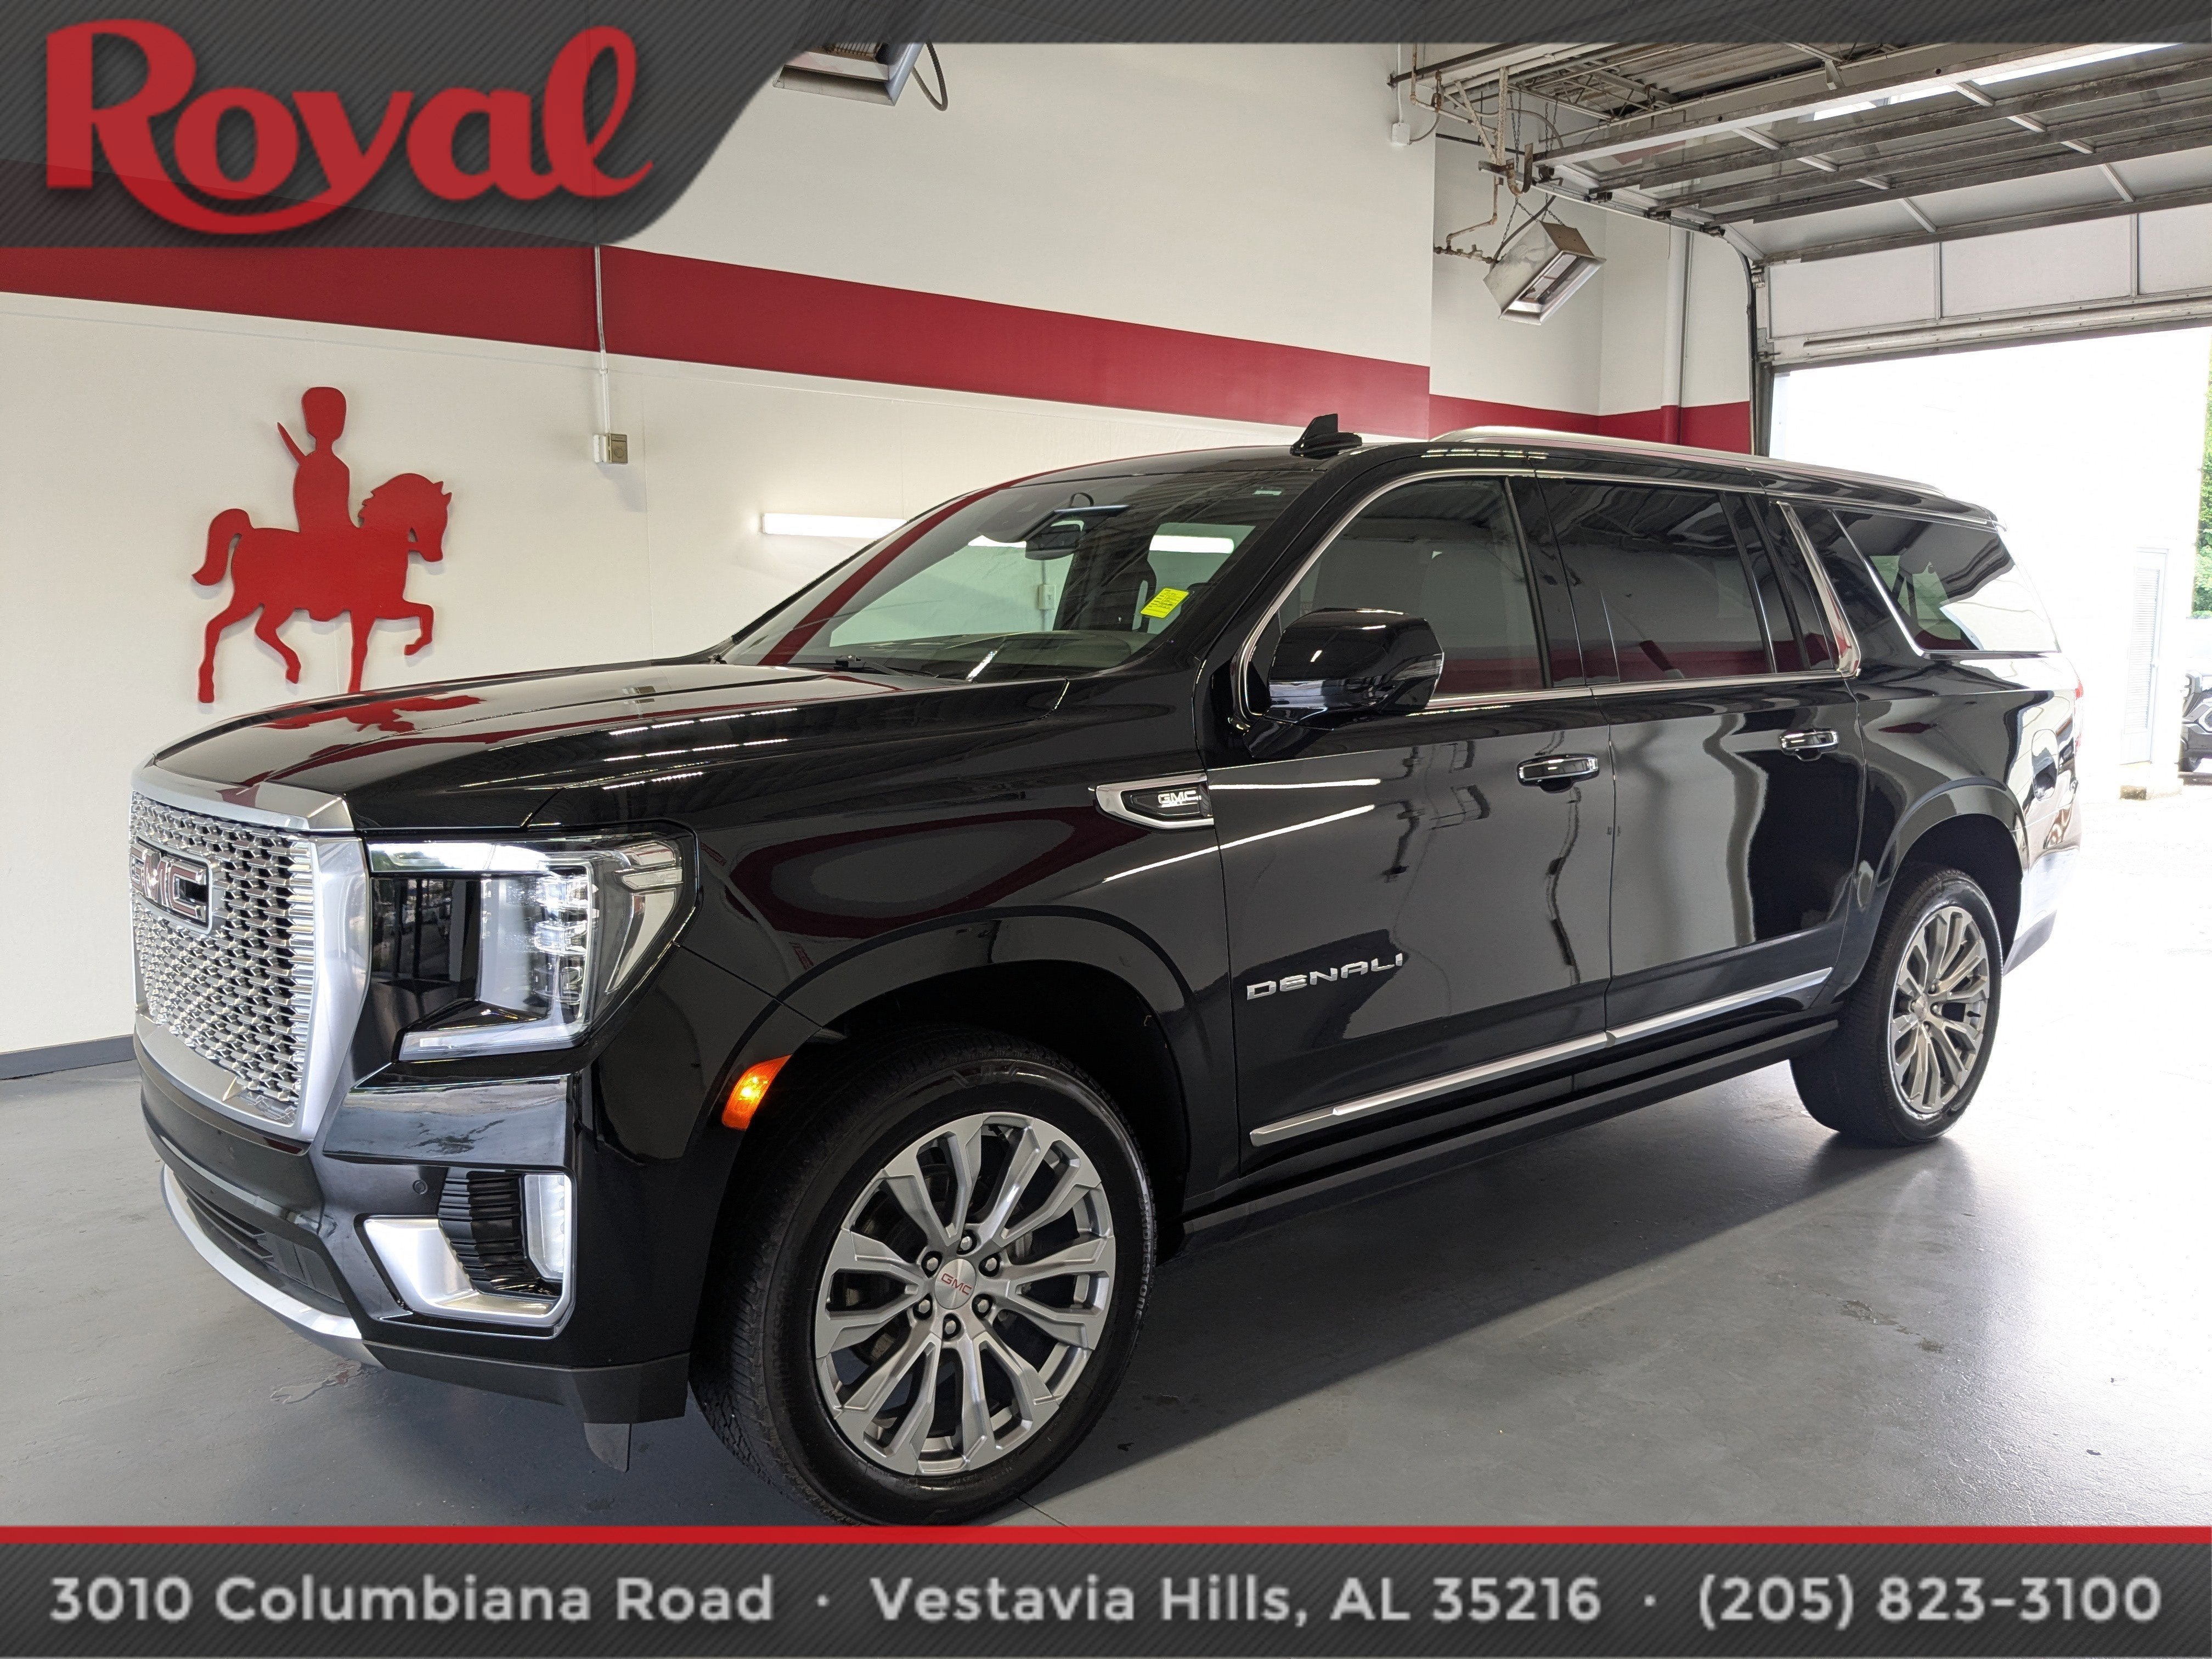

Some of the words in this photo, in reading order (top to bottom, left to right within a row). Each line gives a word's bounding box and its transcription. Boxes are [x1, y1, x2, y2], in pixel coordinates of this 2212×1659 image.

[1158, 791, 1200, 805] GMC
[129, 845, 207, 923] GMC
[1246, 952, 1403, 1001] DENALI
[940, 1272, 972, 1296] GMC
